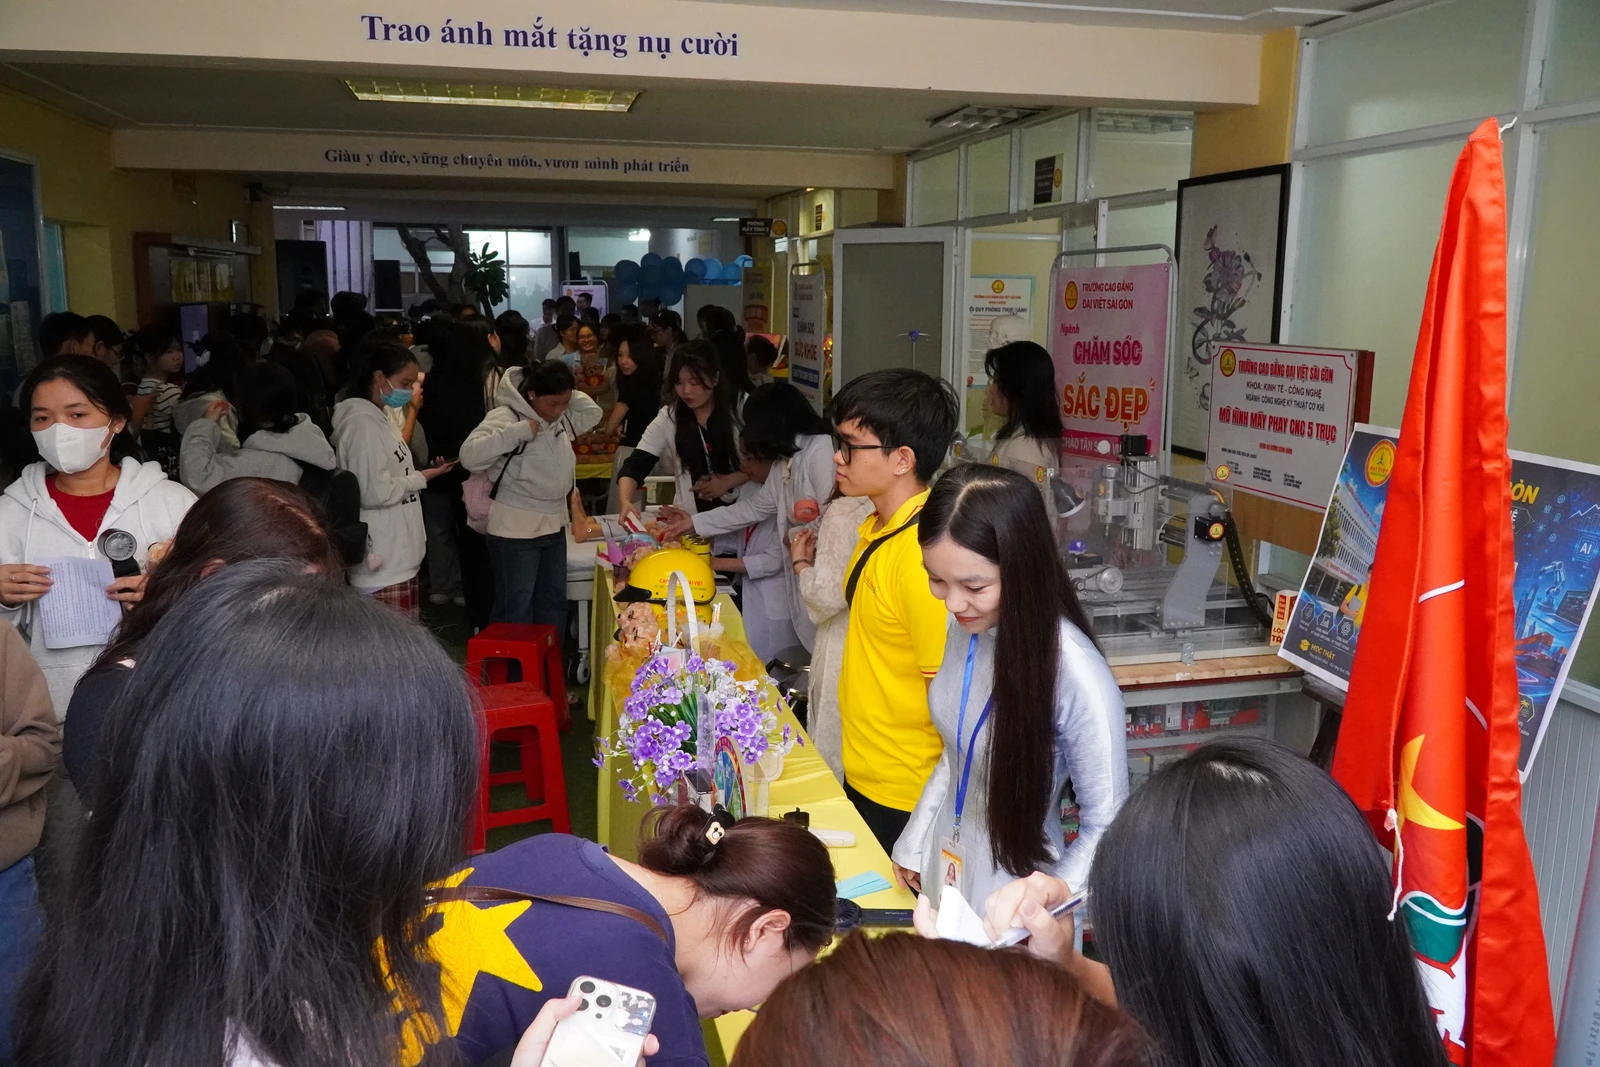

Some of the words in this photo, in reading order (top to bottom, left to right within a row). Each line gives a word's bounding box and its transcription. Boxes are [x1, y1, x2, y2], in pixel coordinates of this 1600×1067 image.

[361, 15, 430, 42] Trao
[441, 18, 492, 45] ánh
[503, 16, 558, 49] mắt
[568, 27, 628, 58] tặng
[638, 34, 671, 60] nụ
[681, 32, 739, 57] cười
[325, 149, 360, 162] Giàu
[366, 153, 374, 166] y
[412, 152, 448, 168] vững
[453, 153, 502, 169] chuyên
[545, 158, 578, 169] vươn
[585, 156, 618, 170] mình
[624, 158, 652, 174] phát
[658, 157, 689, 172] triển
[1082, 281, 1104, 292] TRƯỜNG
[1104, 282, 1116, 292] CAO
[1117, 280, 1134, 292] ĐẲNG
[1082, 299, 1092, 311] ĐẠI
[1093, 297, 1106, 312] VIỆT
[1107, 297, 1118, 309] SÀI
[1118, 297, 1133, 309] GÒN
[1060, 323, 1079, 336] Ngành
[1073, 336, 1110, 365] CHĂM
[1239, 359, 1257, 374] TRƯỜNG
[1259, 362, 1269, 376] CAO
[1270, 358, 1285, 378] ĐẲNG
[1286, 365, 1296, 381] ĐẠI
[1297, 364, 1309, 383] VIỆT
[1309, 364, 1319, 382] SÀI
[1321, 366, 1334, 384] GÒN
[1063, 372, 1100, 420] SẮC
[1104, 386, 1149, 432] ĐẸP
[1246, 381, 1262, 390] KHOA:
[1264, 384, 1276, 392] KINH
[1277, 384, 1284, 393] TẾ
[1288, 385, 1304, 395] CÔNG
[1306, 389, 1322, 400] NGHỆ
[1262, 395, 1274, 404] CÔNG
[1274, 397, 1286, 407] NGHỆ
[1294, 400, 1308, 410] THUẬT
[1317, 402, 1325, 412] KHÍ
[1219, 405, 1230, 424] MÔ
[1232, 406, 1248, 427] HÌNH
[1250, 410, 1266, 430] MÁY
[1268, 415, 1287, 433] PHAY
[1290, 419, 1305, 436] CNC
[1307, 423, 1313, 439] 5
[1316, 423, 1337, 445] TRỤC
[1510, 479, 1540, 504] ÒN
[1580, 543, 1592, 554] AI
